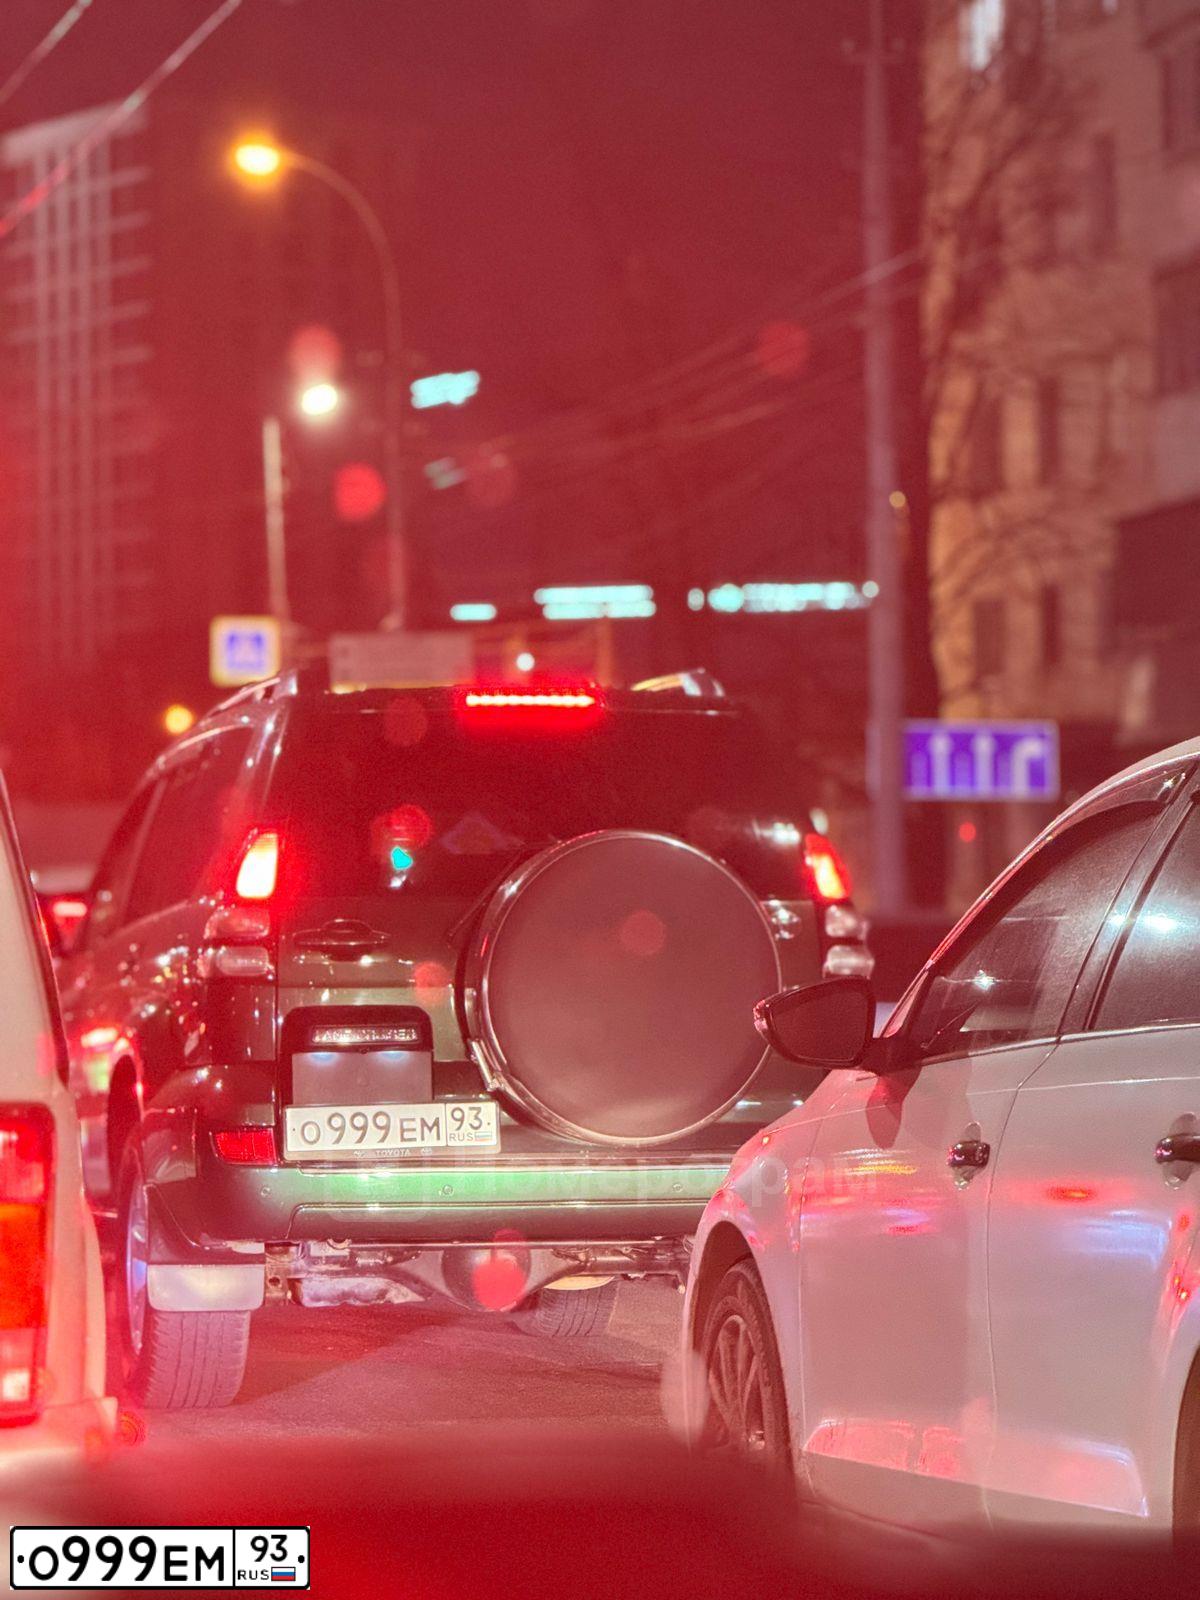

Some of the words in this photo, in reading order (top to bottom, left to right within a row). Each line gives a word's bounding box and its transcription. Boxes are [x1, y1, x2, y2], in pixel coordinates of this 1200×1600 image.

[450, 1106, 483, 1132] 93
[449, 1131, 474, 1142] RUS
[375, 1148, 411, 1158] TOYOTA
